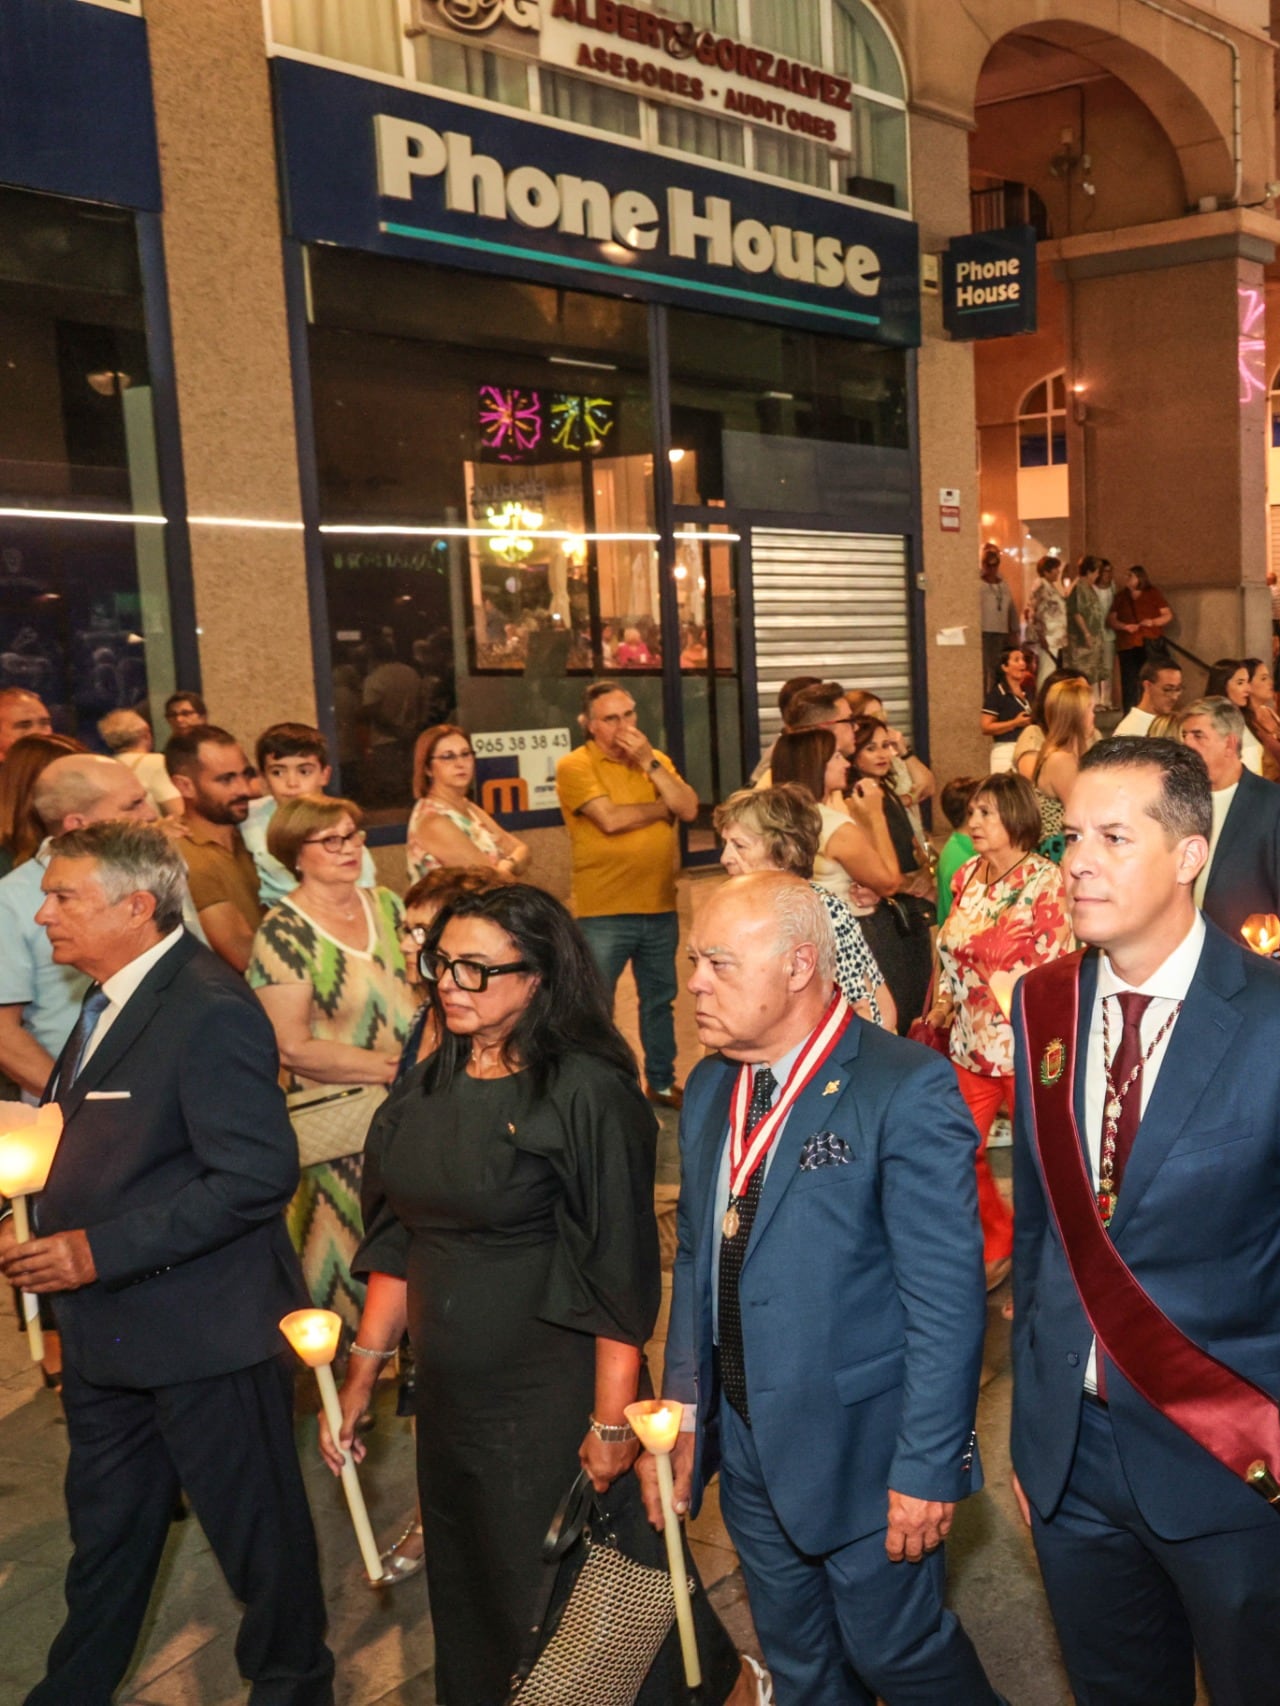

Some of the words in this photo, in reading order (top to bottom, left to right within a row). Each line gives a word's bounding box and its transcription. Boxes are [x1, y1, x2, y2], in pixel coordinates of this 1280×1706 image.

[576, 43, 704, 100] ASESORES
[724, 87, 836, 142] AUDITORES
[373, 113, 659, 250] Phone
[666, 187, 880, 296] House
[956, 258, 1020, 283] Phone
[956, 282, 1020, 307] House
[475, 737, 505, 753] 965
[508, 736, 527, 752] 38
[531, 735, 549, 750] 38
[552, 733, 569, 748] 43
